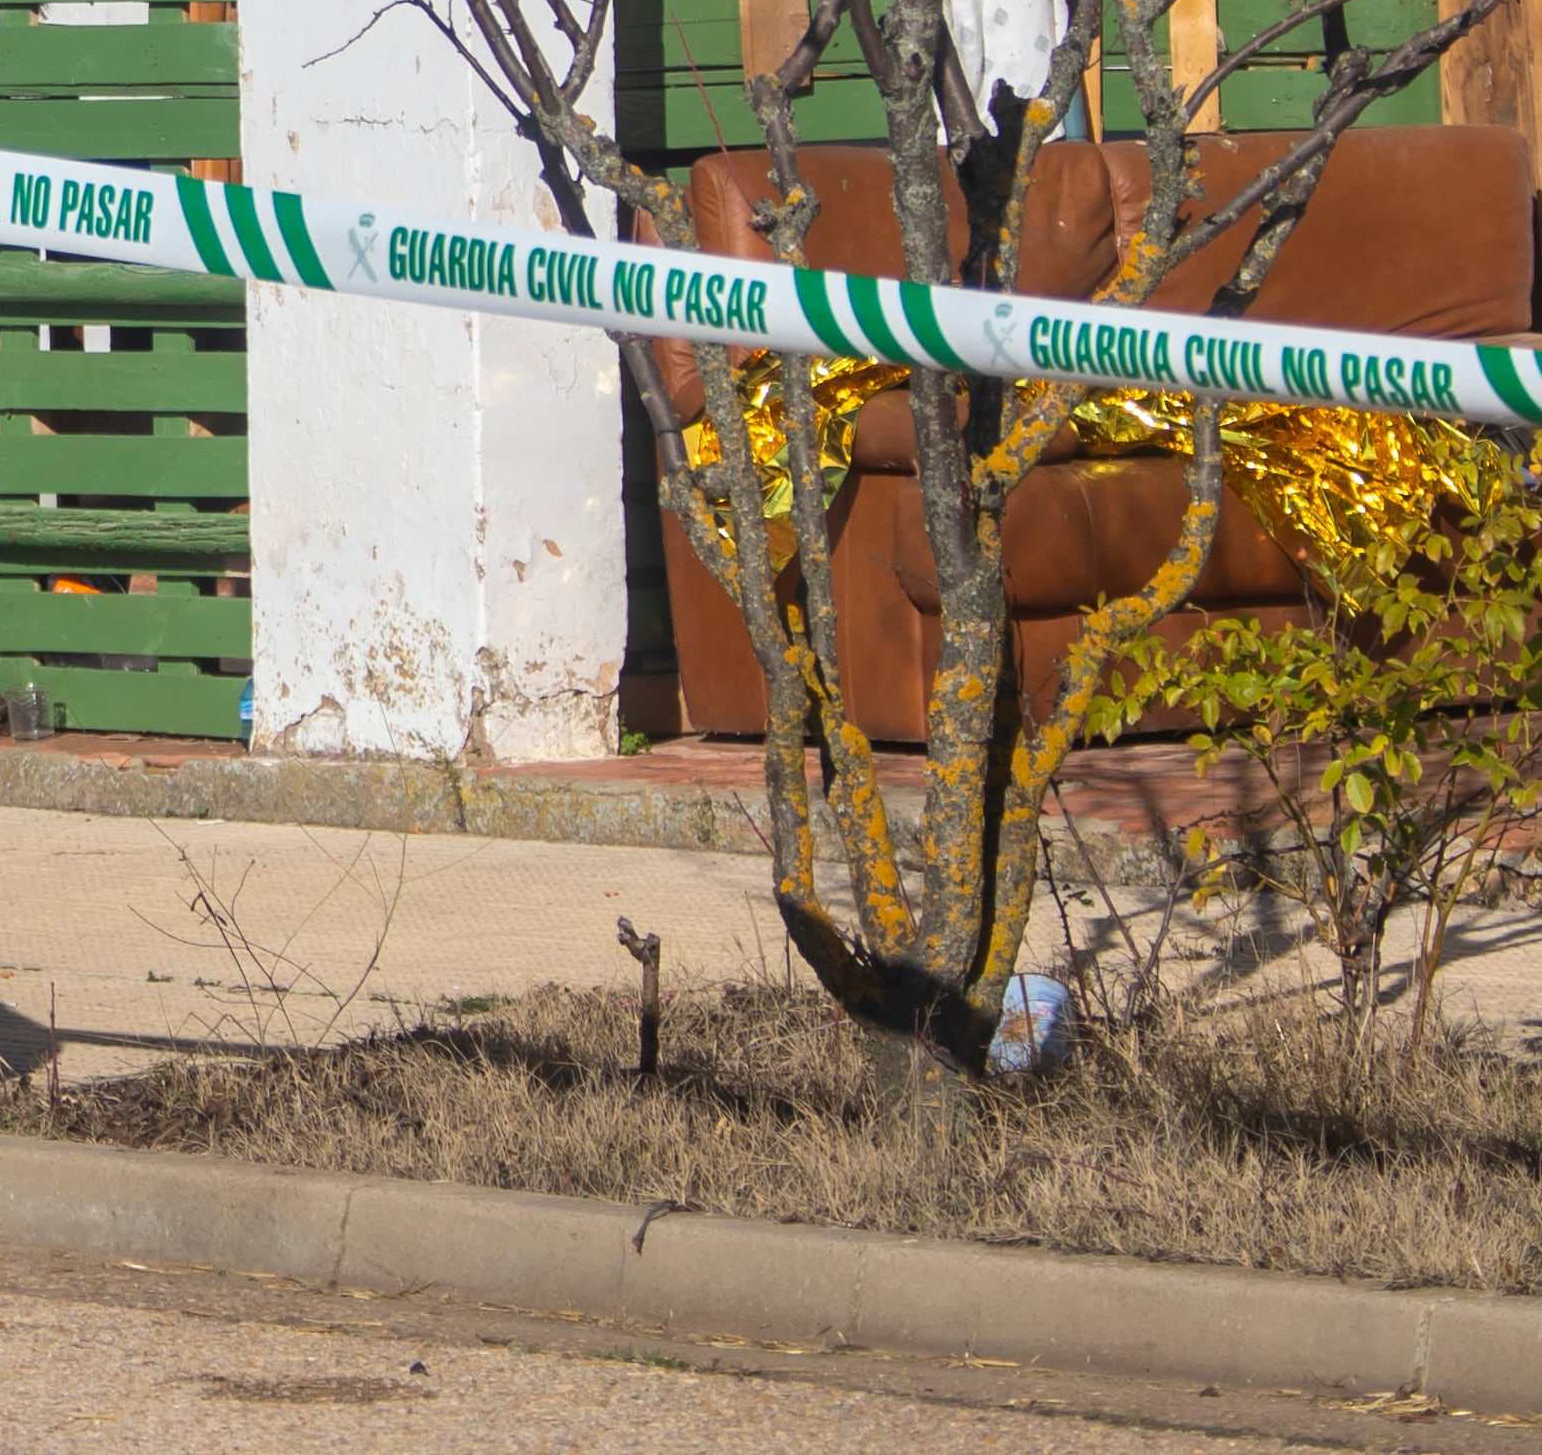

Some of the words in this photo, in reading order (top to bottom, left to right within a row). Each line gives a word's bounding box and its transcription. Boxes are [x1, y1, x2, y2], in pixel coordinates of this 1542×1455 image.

[11, 172, 52, 229] NO
[59, 179, 155, 244] PASAR
[389, 225, 518, 298] GUARDIA
[527, 247, 604, 311] CIVIL
[613, 260, 656, 319] NO
[665, 267, 770, 335] PASAR
[1029, 315, 1178, 385] GUARDIA
[1185, 334, 1277, 396] CIVIL
[1282, 346, 1334, 402] NO
[1341, 352, 1465, 415] PASAR
